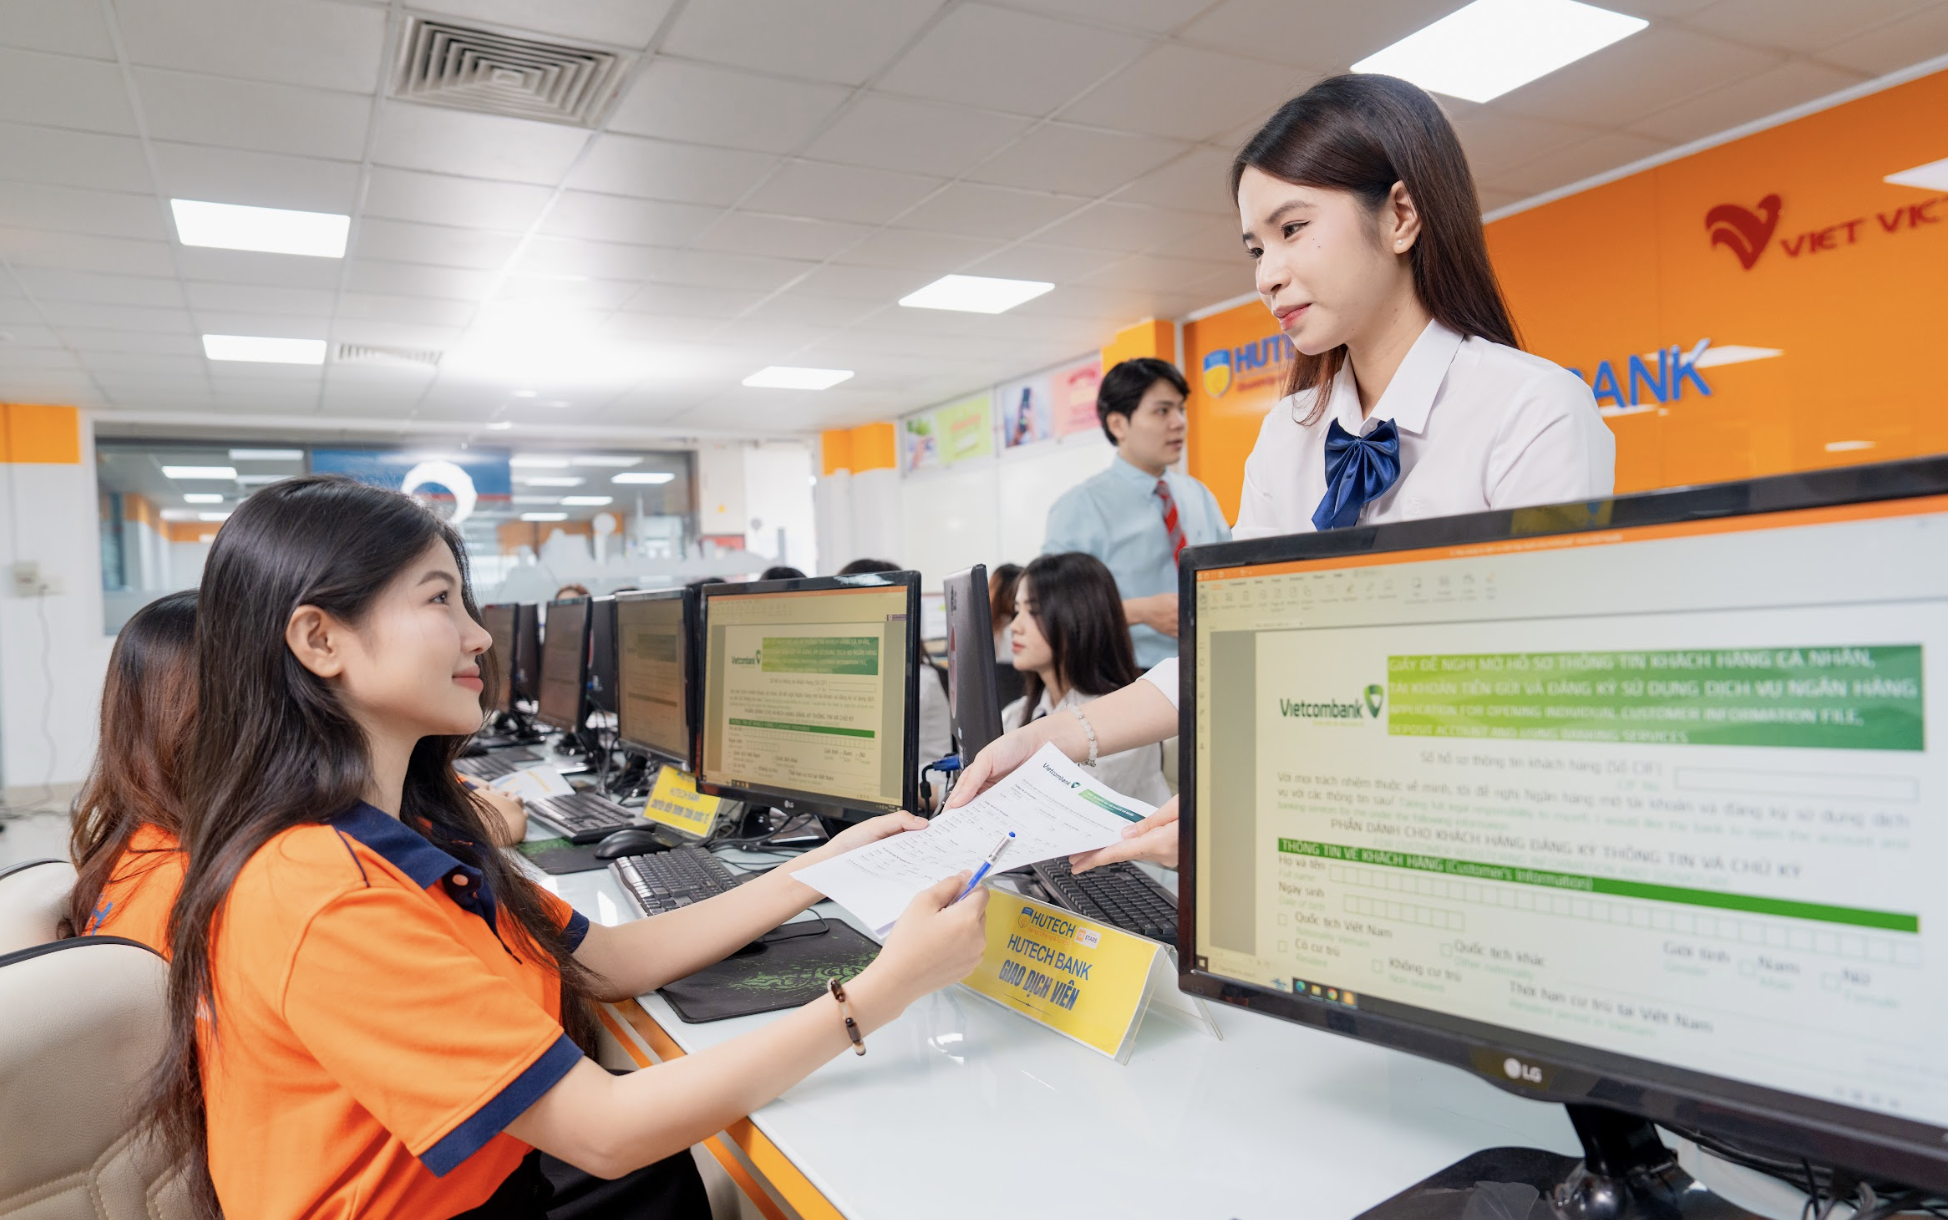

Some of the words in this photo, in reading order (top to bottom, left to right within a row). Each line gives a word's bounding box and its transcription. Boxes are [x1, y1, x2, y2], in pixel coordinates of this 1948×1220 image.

[1234, 333, 1297, 373] HUTE
[1616, 653, 1646, 668] TIN
[1280, 697, 1363, 719] Vietcombank
[1323, 843, 1340, 858] TIN
[1031, 911, 1077, 938] HUTECH
[1006, 933, 1056, 966] HUTECH
[1054, 951, 1093, 981] BANK
[999, 959, 1027, 987] GIAO
[1022, 969, 1054, 999] DỊCH
[1050, 979, 1080, 1011] VIÊN
[1521, 1065, 1543, 1083] LG
